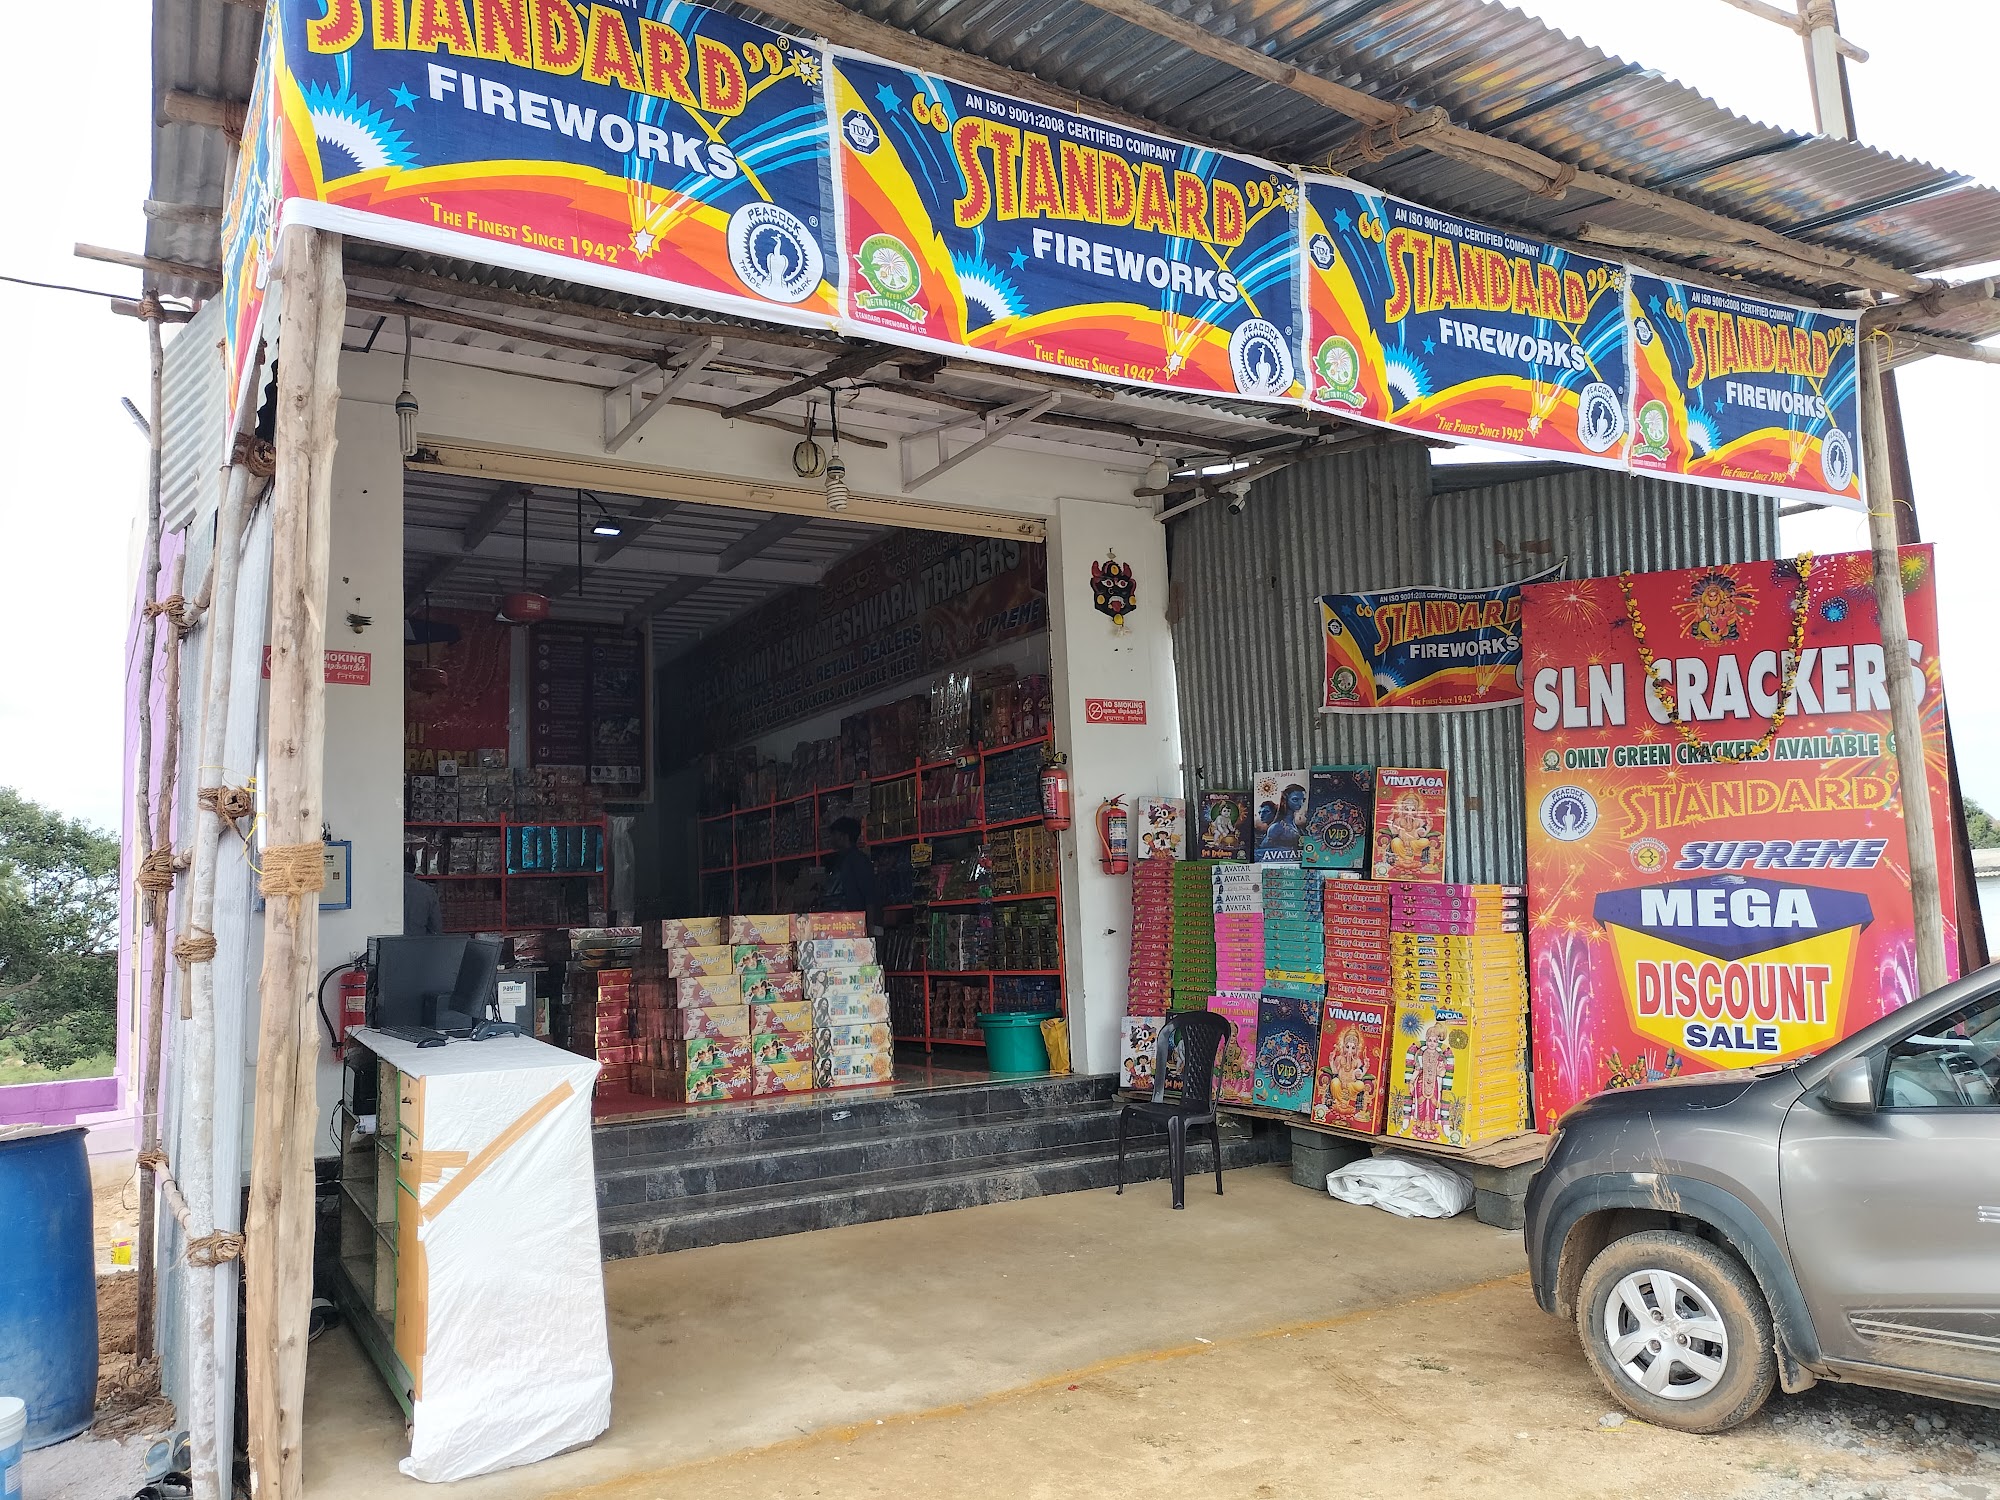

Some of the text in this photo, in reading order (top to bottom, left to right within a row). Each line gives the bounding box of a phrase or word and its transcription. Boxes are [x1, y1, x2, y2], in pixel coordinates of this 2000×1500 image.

[427, 63, 738, 180] FIREWORKS
[965, 93, 1177, 163] AN ISO 9001:2008 CERTIFIED COMPANY
[747, 206, 802, 234] PEACOCK
[1395, 208, 1540, 258] AN ISO 9001:2008 CERTIFIED COMPANY
[739, 259, 812, 297] TRADE MARK
[1033, 228, 1238, 303] FIREWORKS
[1691, 291, 1701, 303] AN
[1740, 303, 1769, 318] CERTIFIED
[1769, 308, 1796, 324] COMPANY
[1243, 323, 1279, 342] PEACOCK
[1439, 317, 1587, 371] FIREWORKS
[1586, 385, 1613, 400] PEACOCK
[1726, 381, 1827, 420] FIREWORKS
[920, 537, 1022, 613] TRADERS
[975, 599, 1042, 643] SUPREME
[324, 653, 366, 664] MOKING
[1409, 635, 1520, 659] FIREWORKS
[773, 677, 802, 704] SALE
[816, 653, 858, 684] RETAIL
[860, 623, 923, 666] DEALERS
[792, 688, 837, 718] CRACKERS
[836, 668, 889, 701] AVAILABLE
[889, 652, 918, 681] HERE
[1532, 663, 1627, 732] SLN
[1114, 701, 1143, 709] SMOKING
[1564, 747, 1610, 769] ONLY
[1614, 744, 1671, 767] GREEN
[1677, 739, 1771, 765] CRACKERS
[1774, 734, 1880, 761] AVAILABLE
[1382, 775, 1444, 788] VINAYAGA
[1551, 788, 1585, 800] PEACOCK
[1154, 806, 1169, 819] 20
[1224, 865, 1250, 873] AVATAR
[1673, 839, 1889, 871] SUPREME
[1224, 874, 1250, 883] AVATAR
[1225, 894, 1252, 903] AVATAR
[1225, 903, 1252, 912] AVATAR
[1641, 889, 1819, 929] MEGA
[813, 921, 856, 932] Star Night
[1637, 961, 1830, 1023] DISCOUNT
[1328, 1007, 1383, 1025] VINAYAGA
[1436, 1012, 1463, 1020] ANDAL
[1135, 1027, 1150, 1040] 20
[1685, 1024, 1779, 1051] SALE
